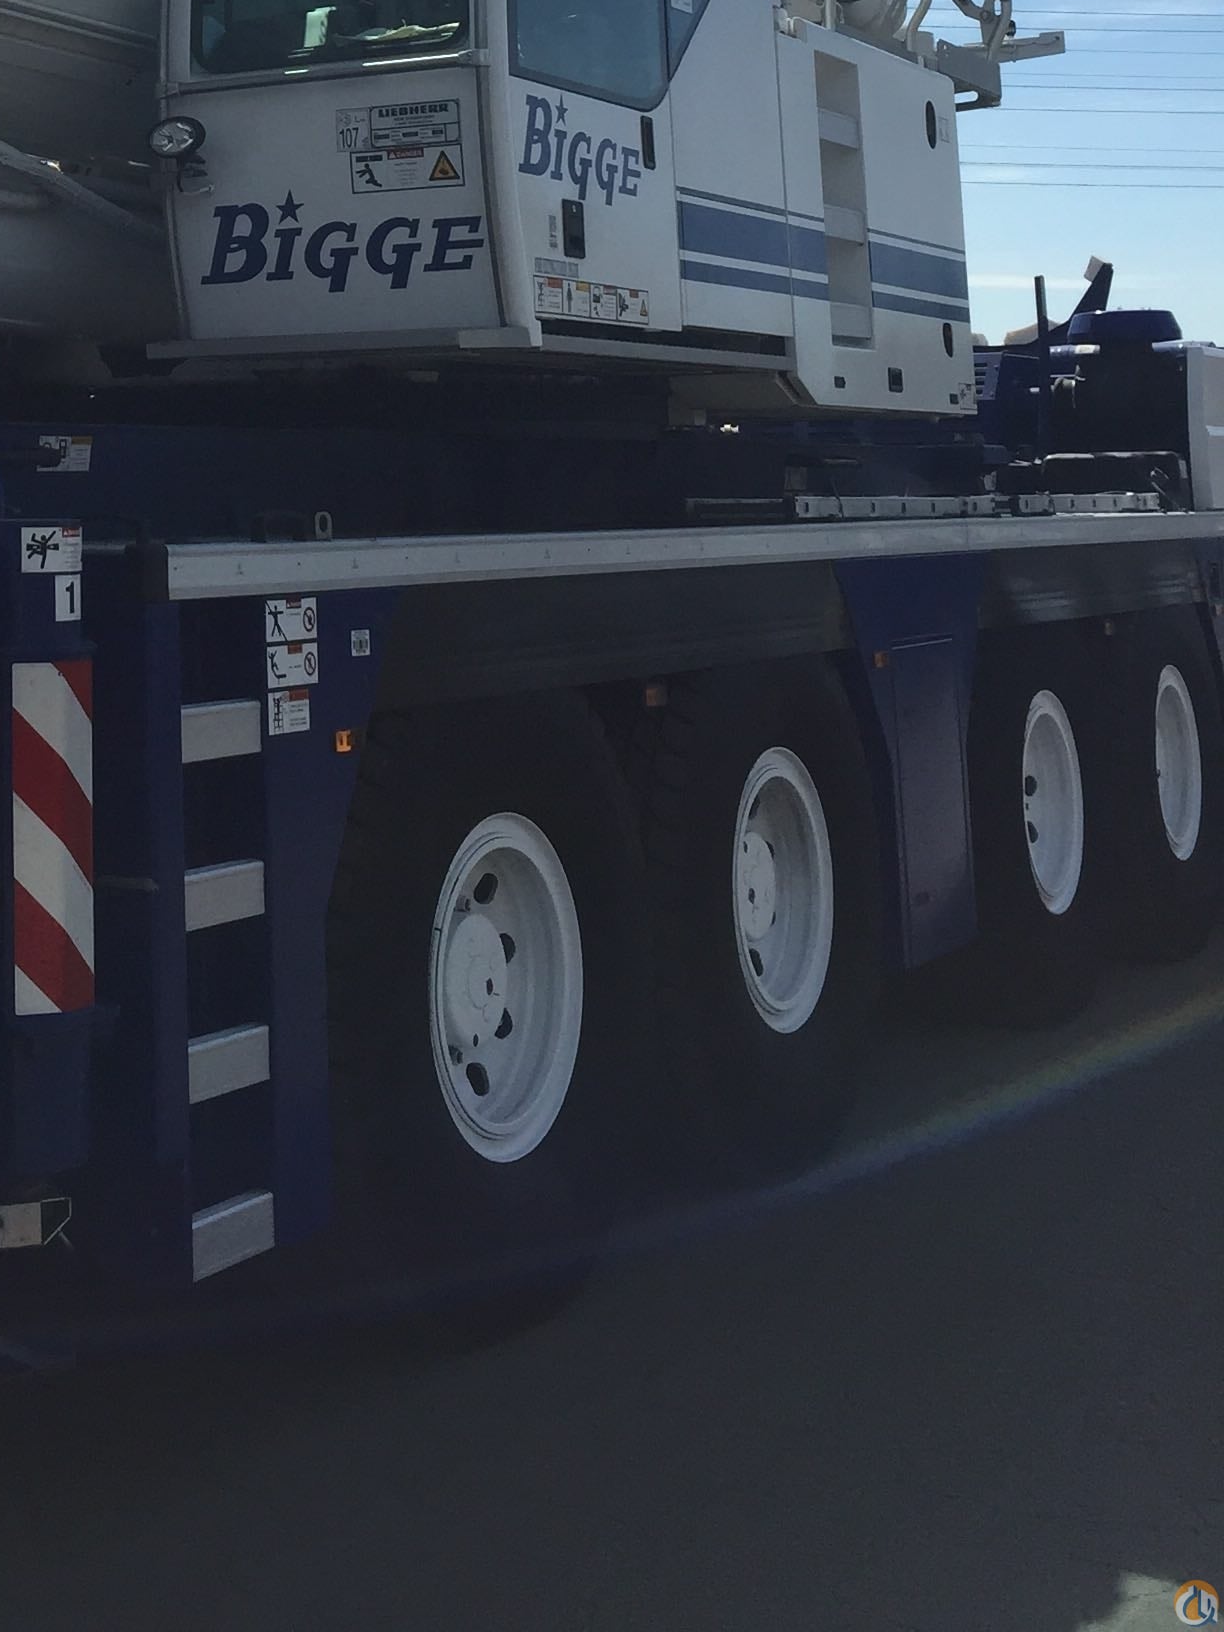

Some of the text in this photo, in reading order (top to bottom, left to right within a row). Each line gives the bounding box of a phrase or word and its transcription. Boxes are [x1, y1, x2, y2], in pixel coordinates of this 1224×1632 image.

[378, 103, 449, 118] LIEBHERR
[339, 127, 359, 148] 107
[65, 581, 75, 614] 1
